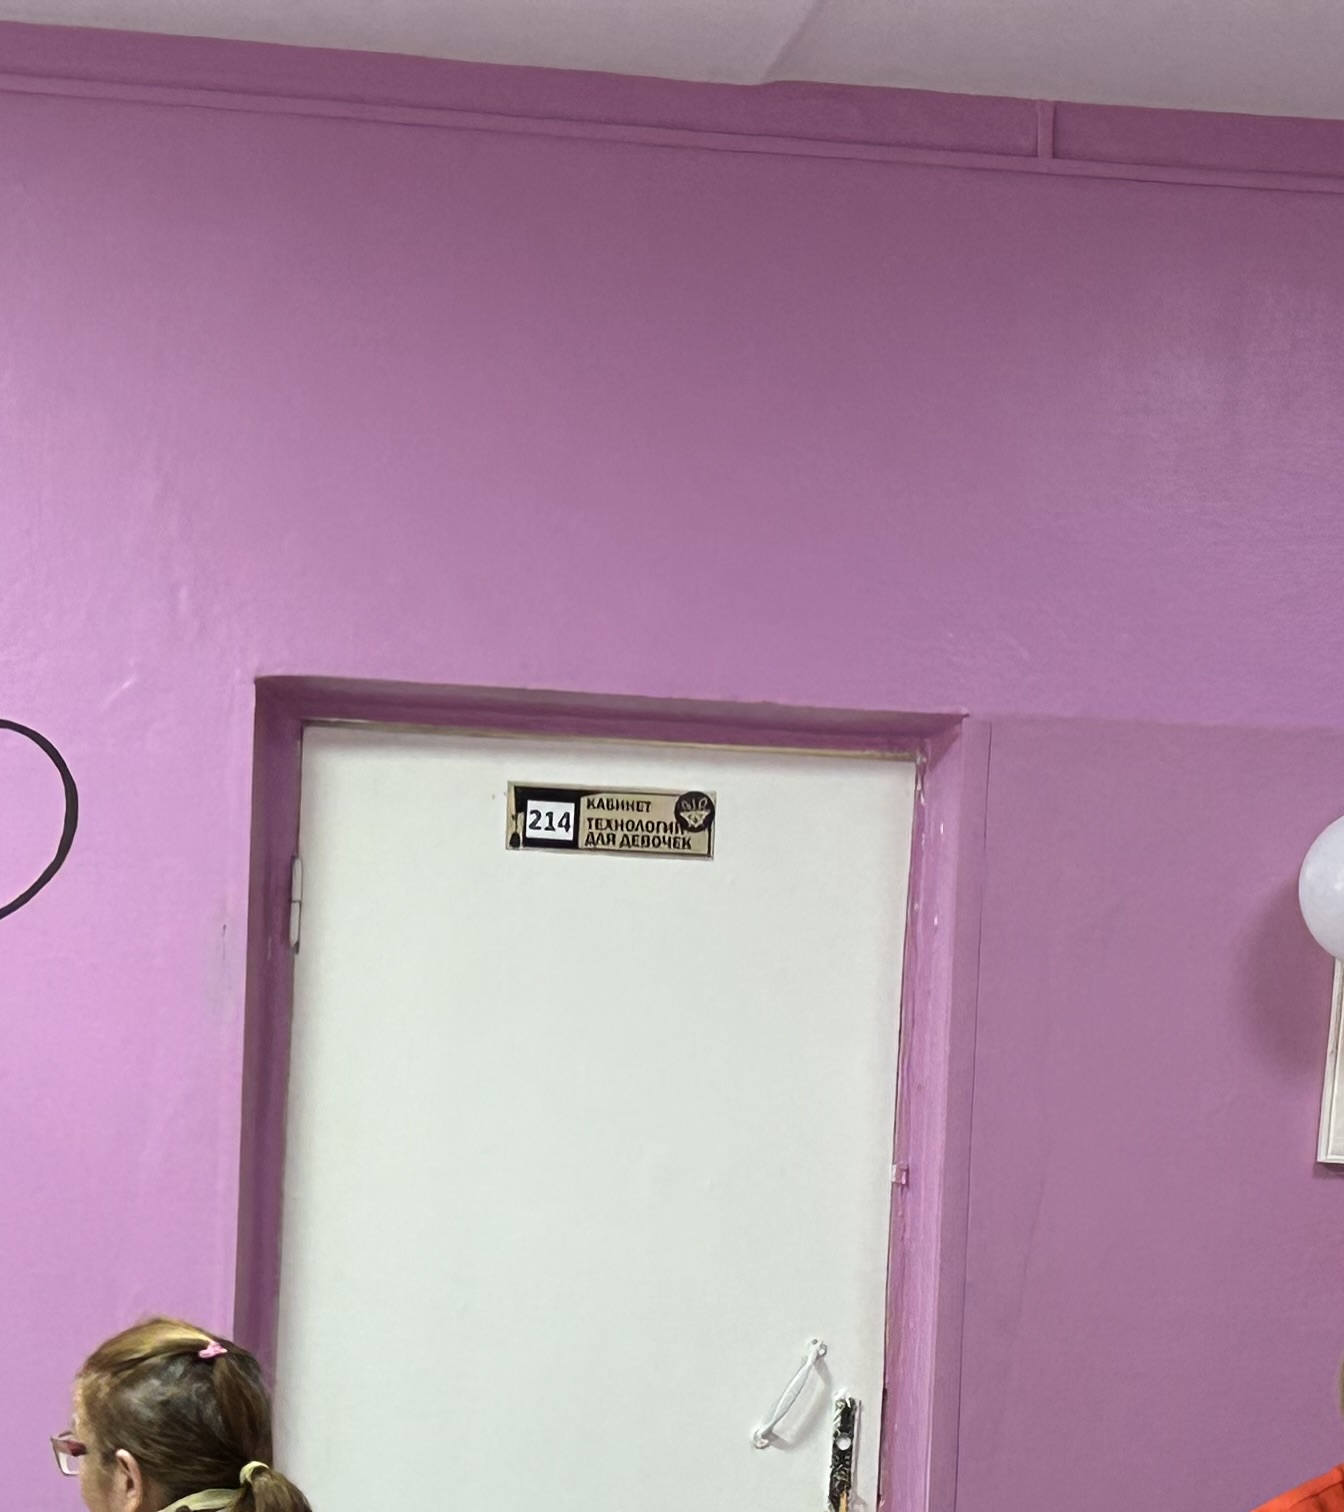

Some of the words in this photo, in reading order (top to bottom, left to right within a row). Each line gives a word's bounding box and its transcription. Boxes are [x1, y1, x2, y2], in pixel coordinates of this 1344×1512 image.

[586, 798, 652, 813] КАБИНЕТ
[528, 809, 571, 833] 214
[585, 831, 616, 847] ДЛЯ
[619, 833, 692, 850] ДЕВОЧЕК
